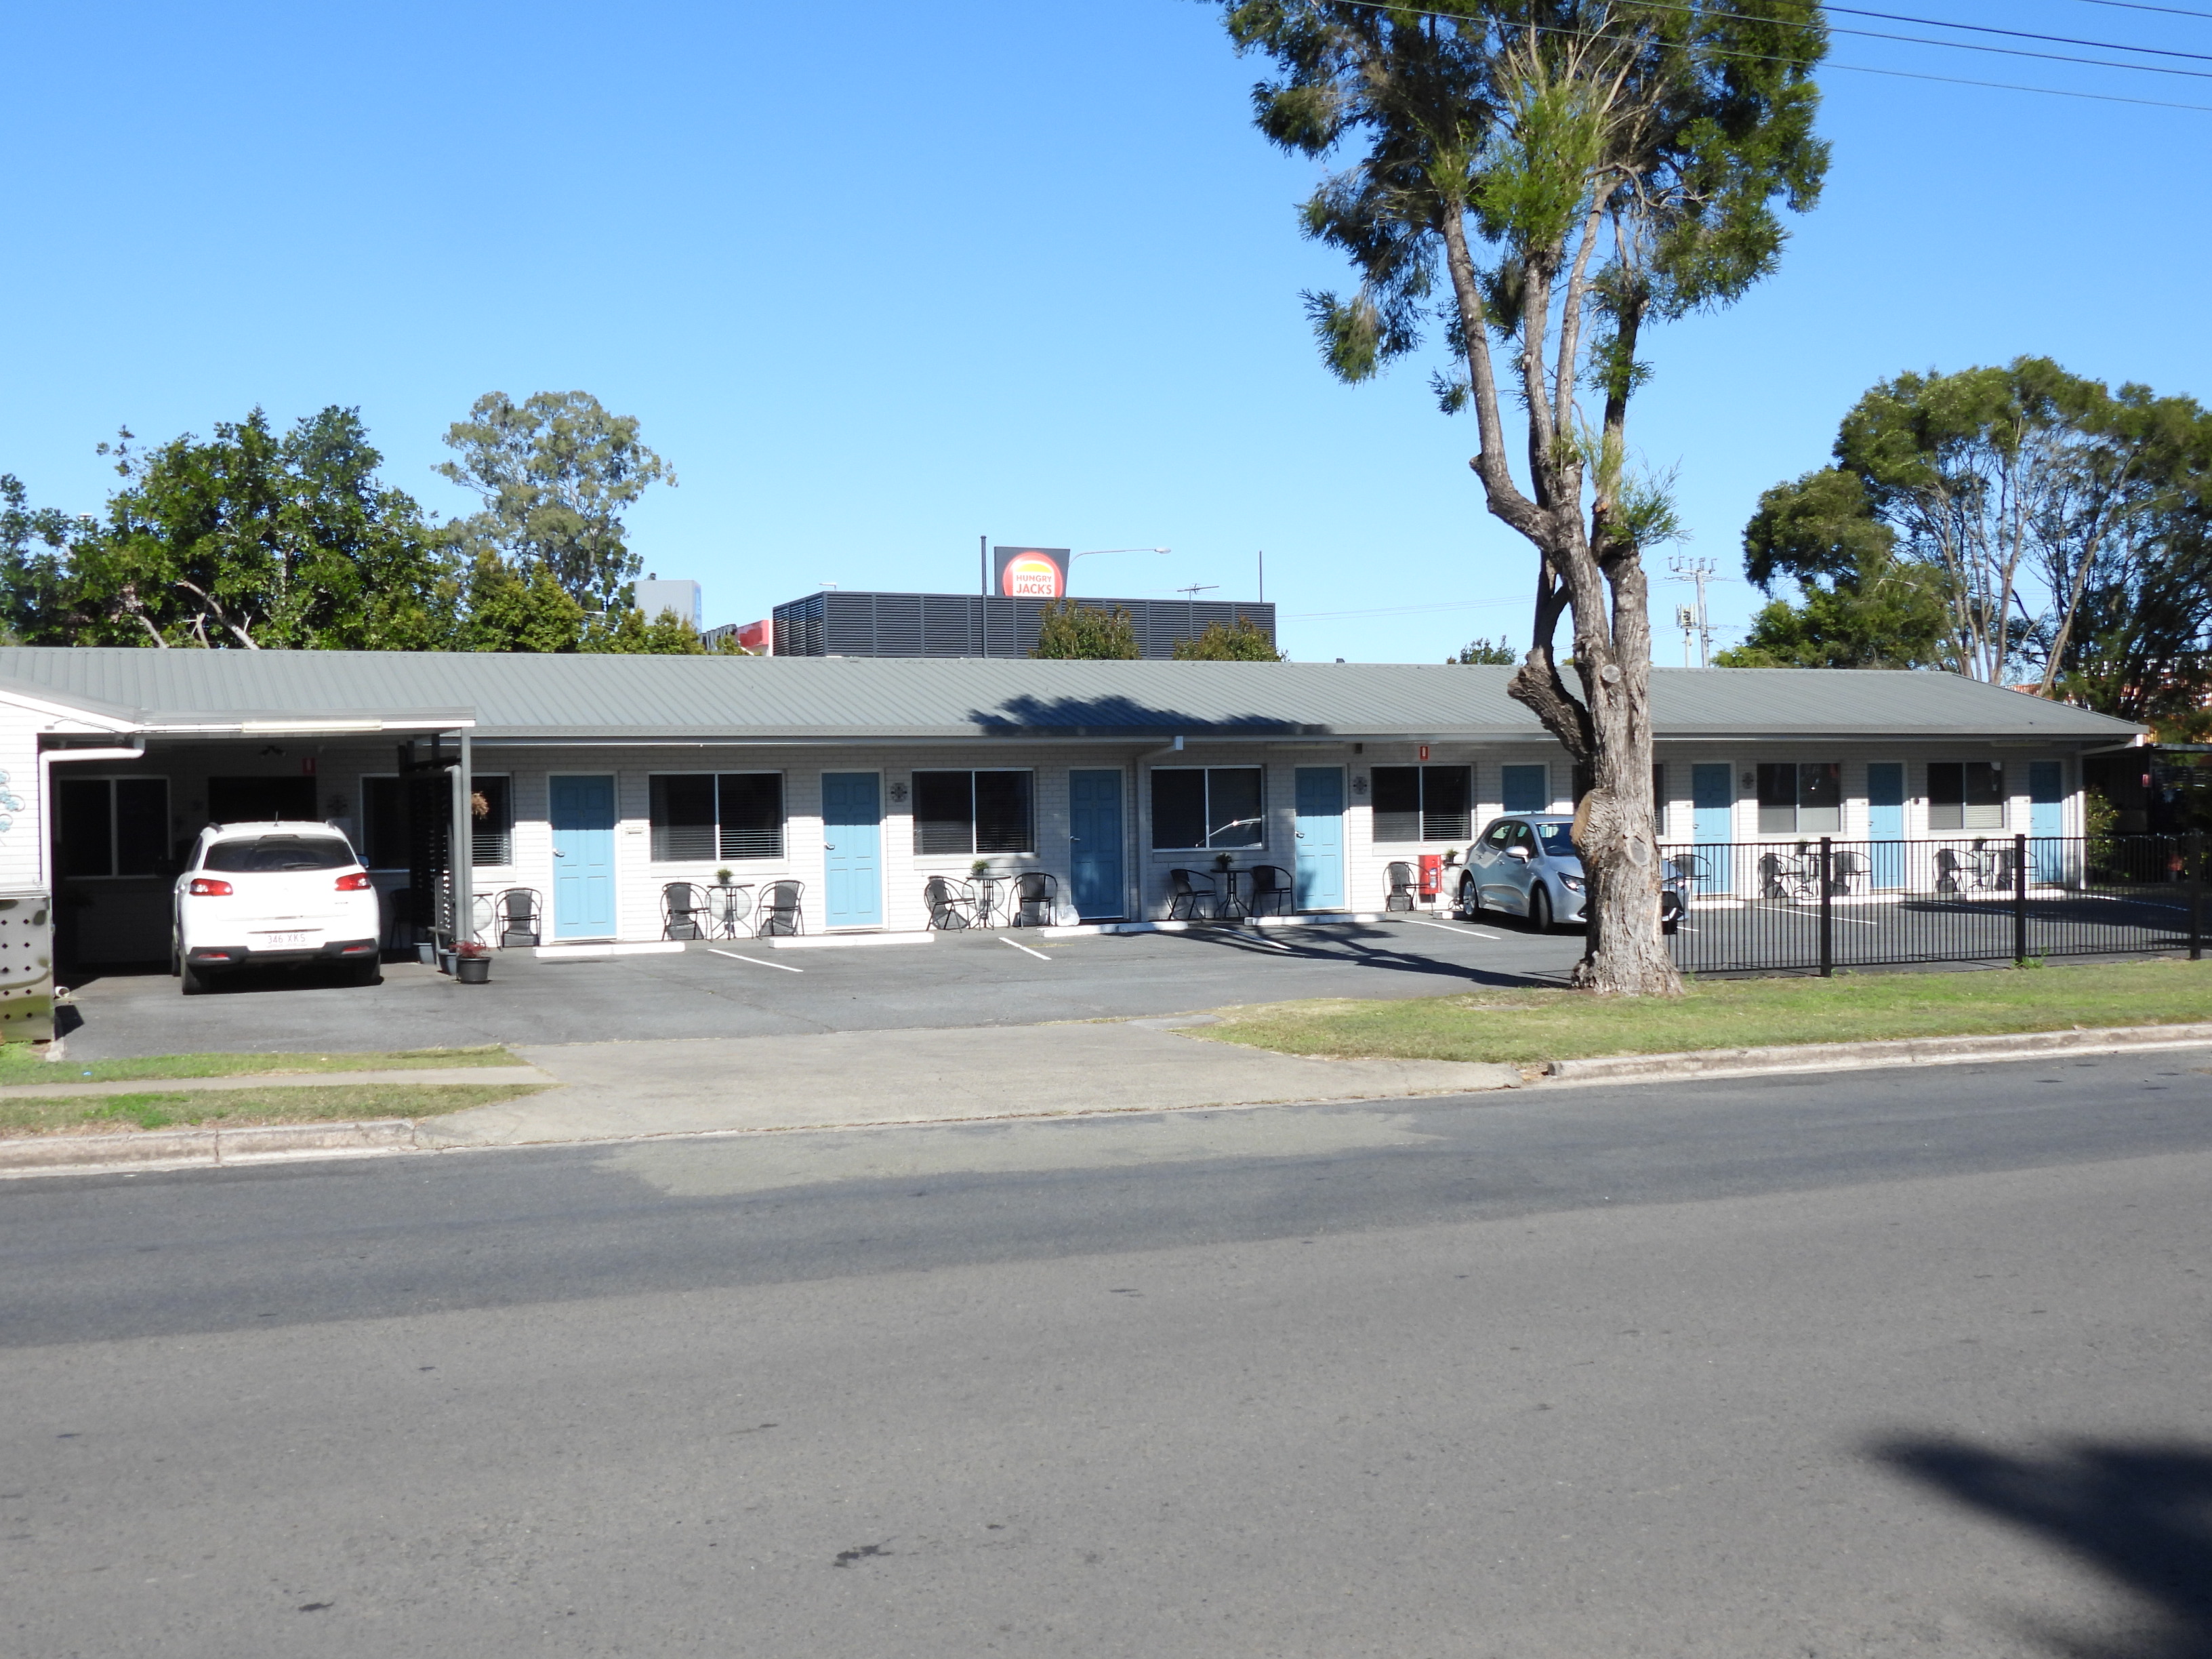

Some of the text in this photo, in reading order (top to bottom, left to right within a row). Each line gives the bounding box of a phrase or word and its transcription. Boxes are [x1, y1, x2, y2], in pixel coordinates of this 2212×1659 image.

[1016, 583, 1052, 595] JACK'S
[268, 933, 306, 944] 346 XKS
